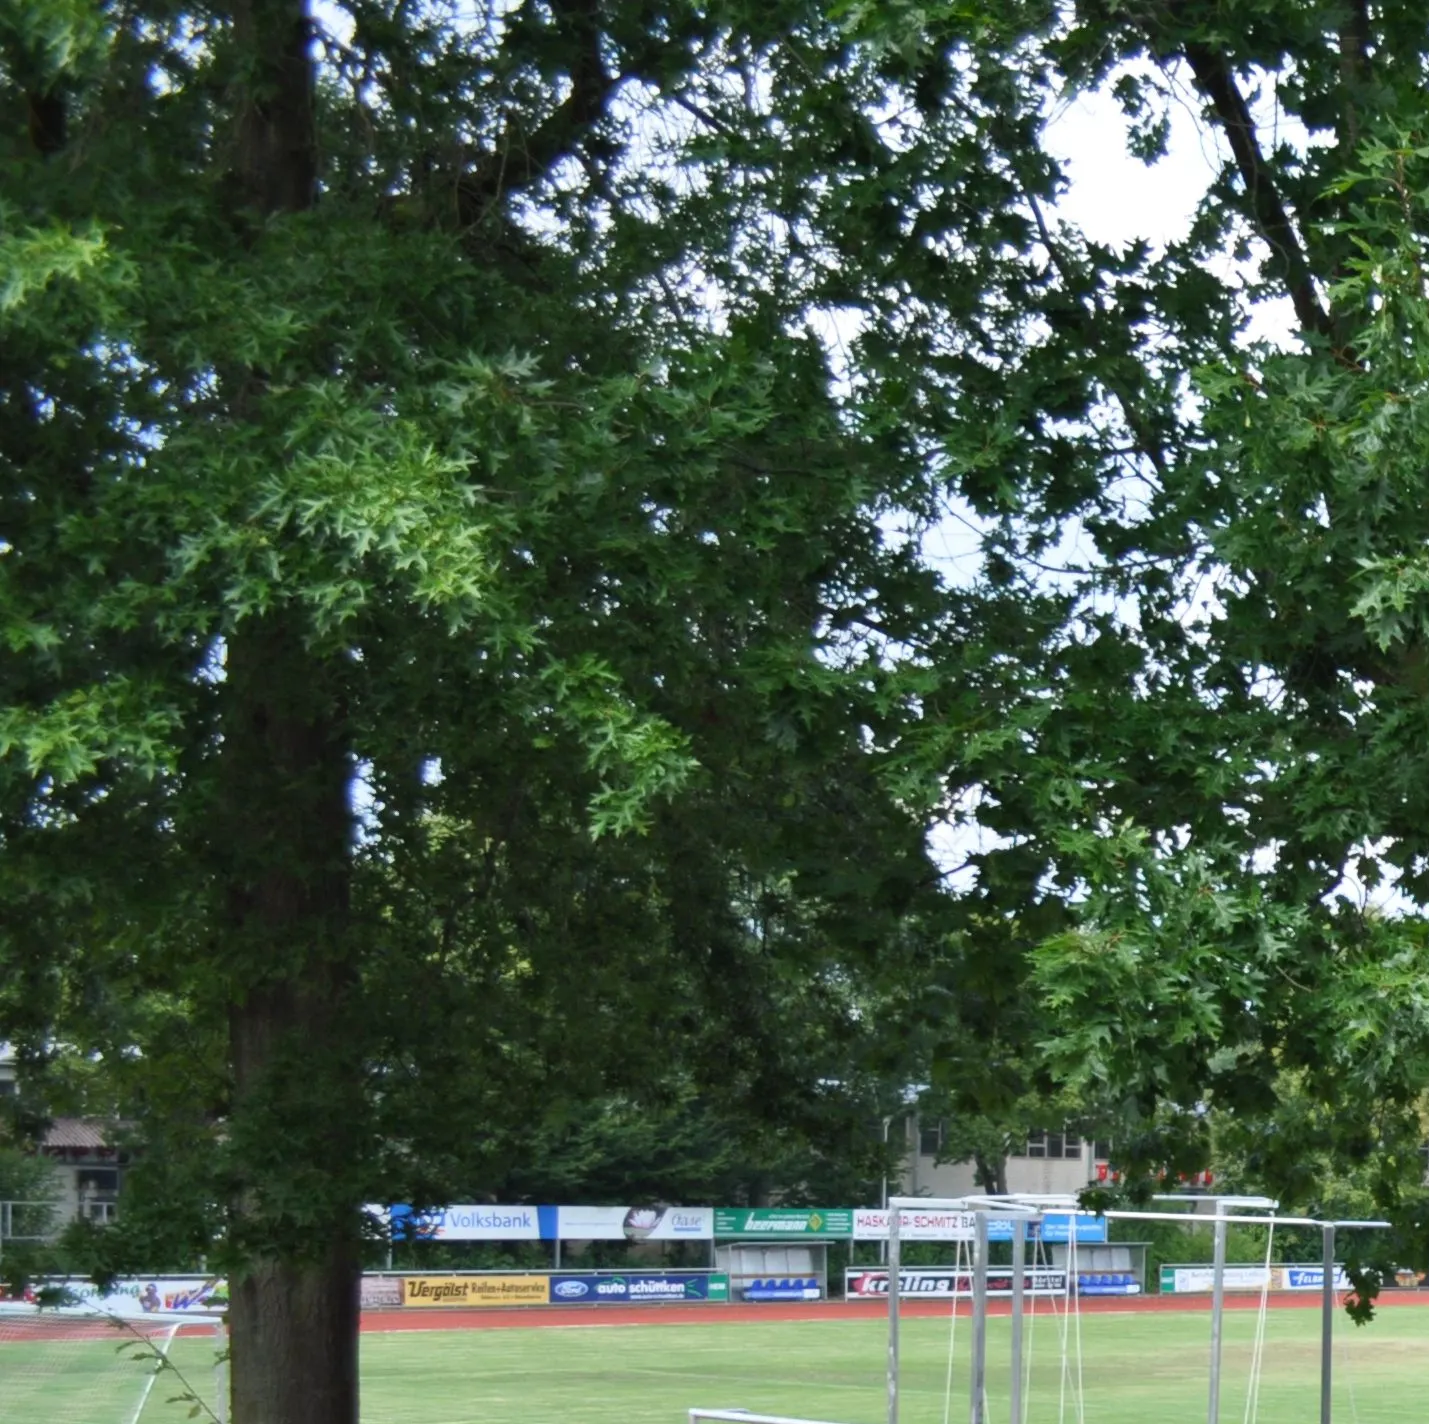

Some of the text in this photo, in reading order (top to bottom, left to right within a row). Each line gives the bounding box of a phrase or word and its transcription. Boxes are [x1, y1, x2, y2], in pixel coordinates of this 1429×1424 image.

[450, 1212, 532, 1228] Volksbank
[407, 1281, 469, 1301] Vergölst
[597, 1280, 685, 1294] auto schüttken
